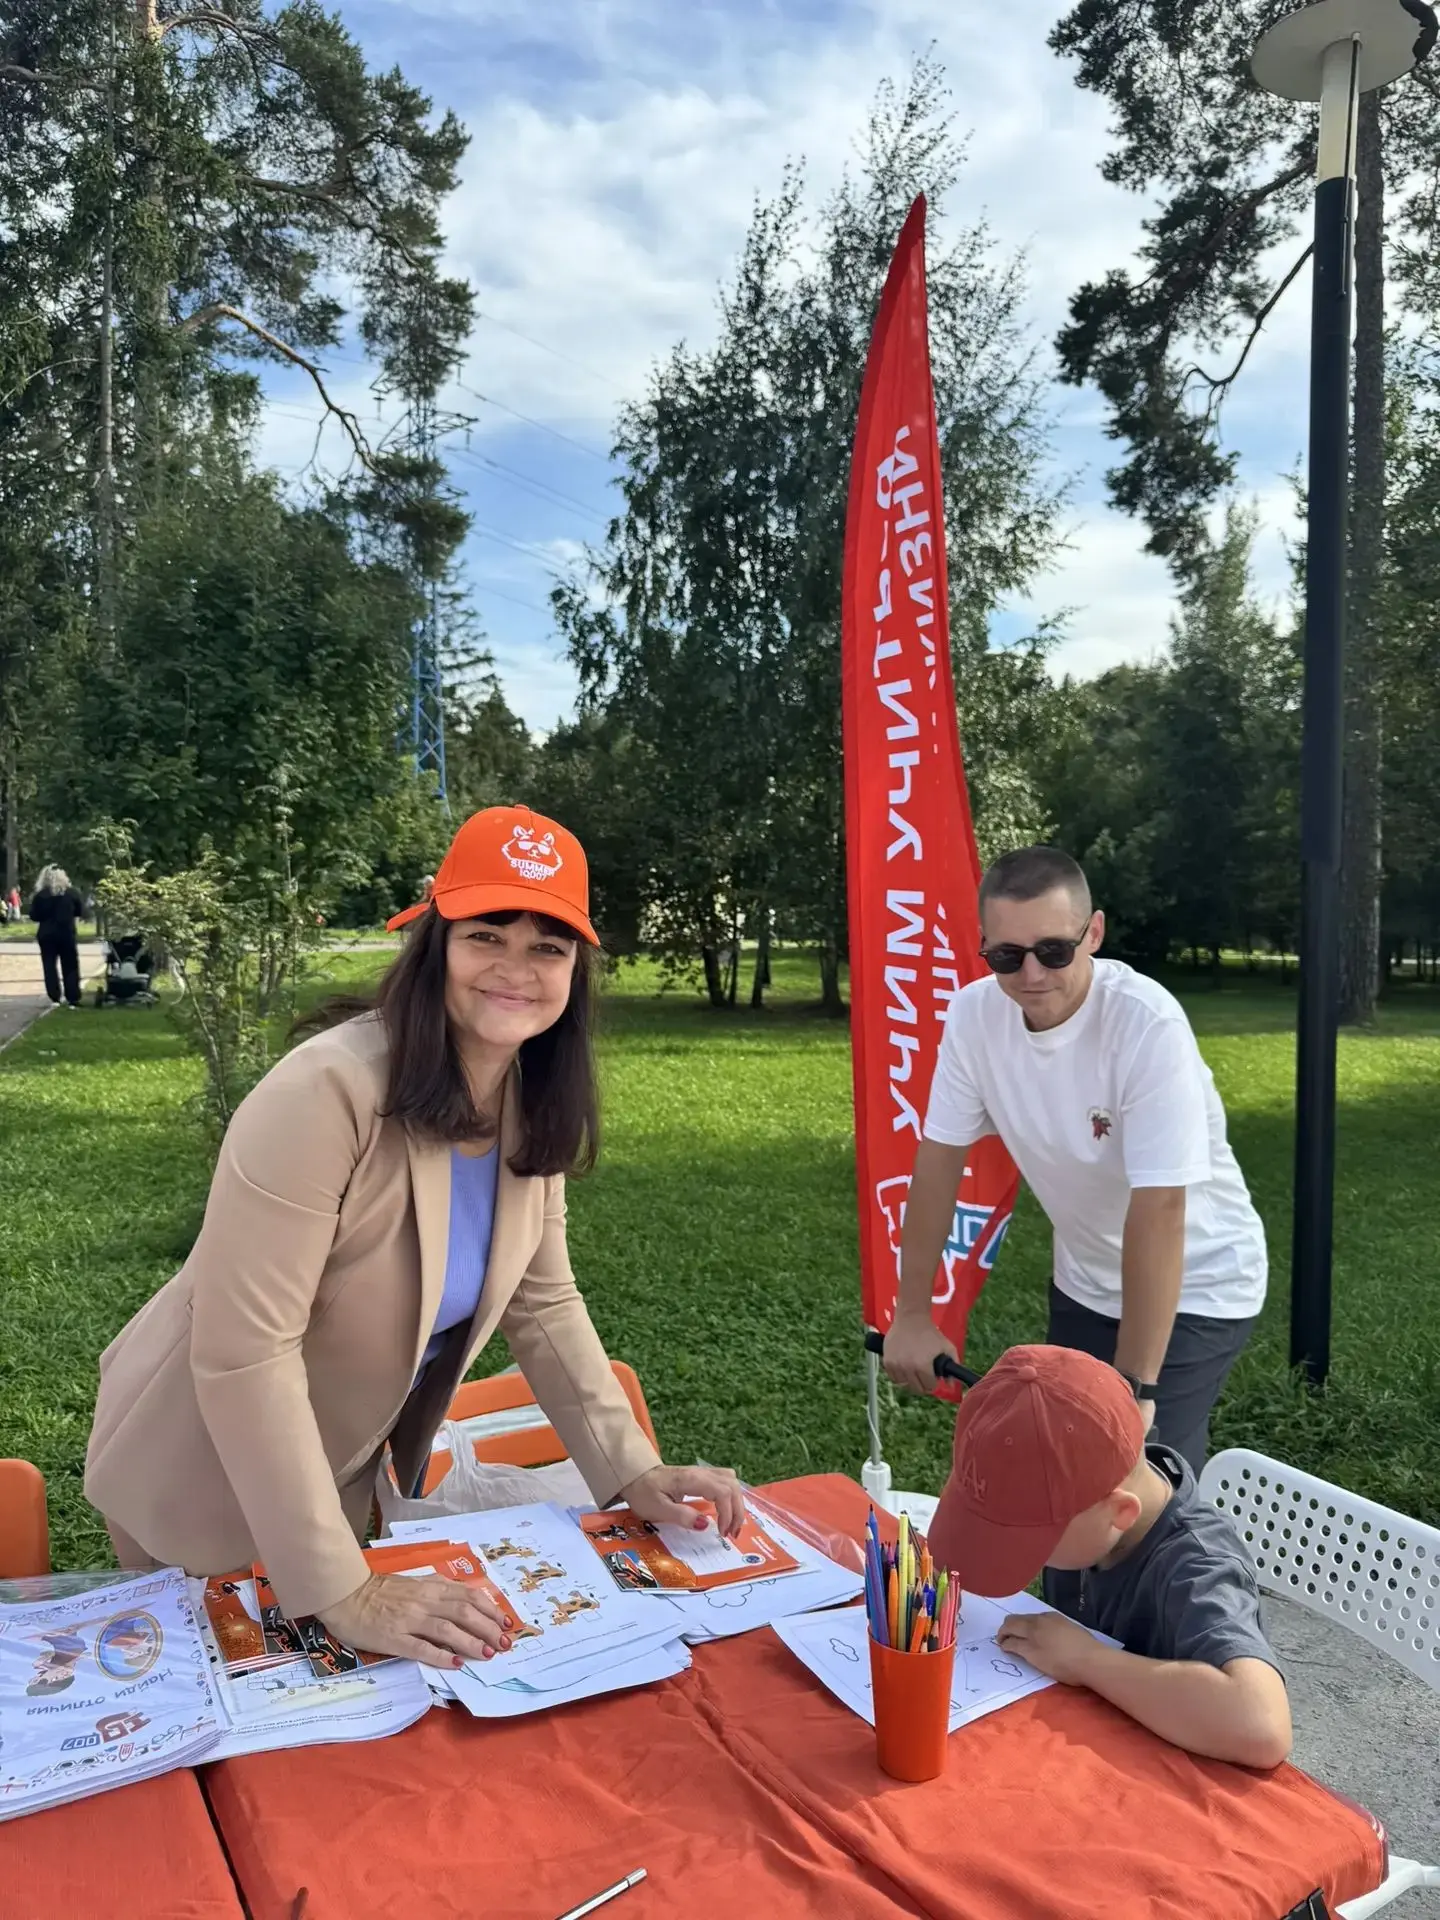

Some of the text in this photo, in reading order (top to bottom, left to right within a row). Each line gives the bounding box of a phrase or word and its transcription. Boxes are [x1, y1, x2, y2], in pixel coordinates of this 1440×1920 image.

[873, 453, 925, 1142] УЧИМ УЧИТЬЯ
[510, 859, 555, 877] SUMMER
[26, 1668, 174, 1716] Найди отличия
